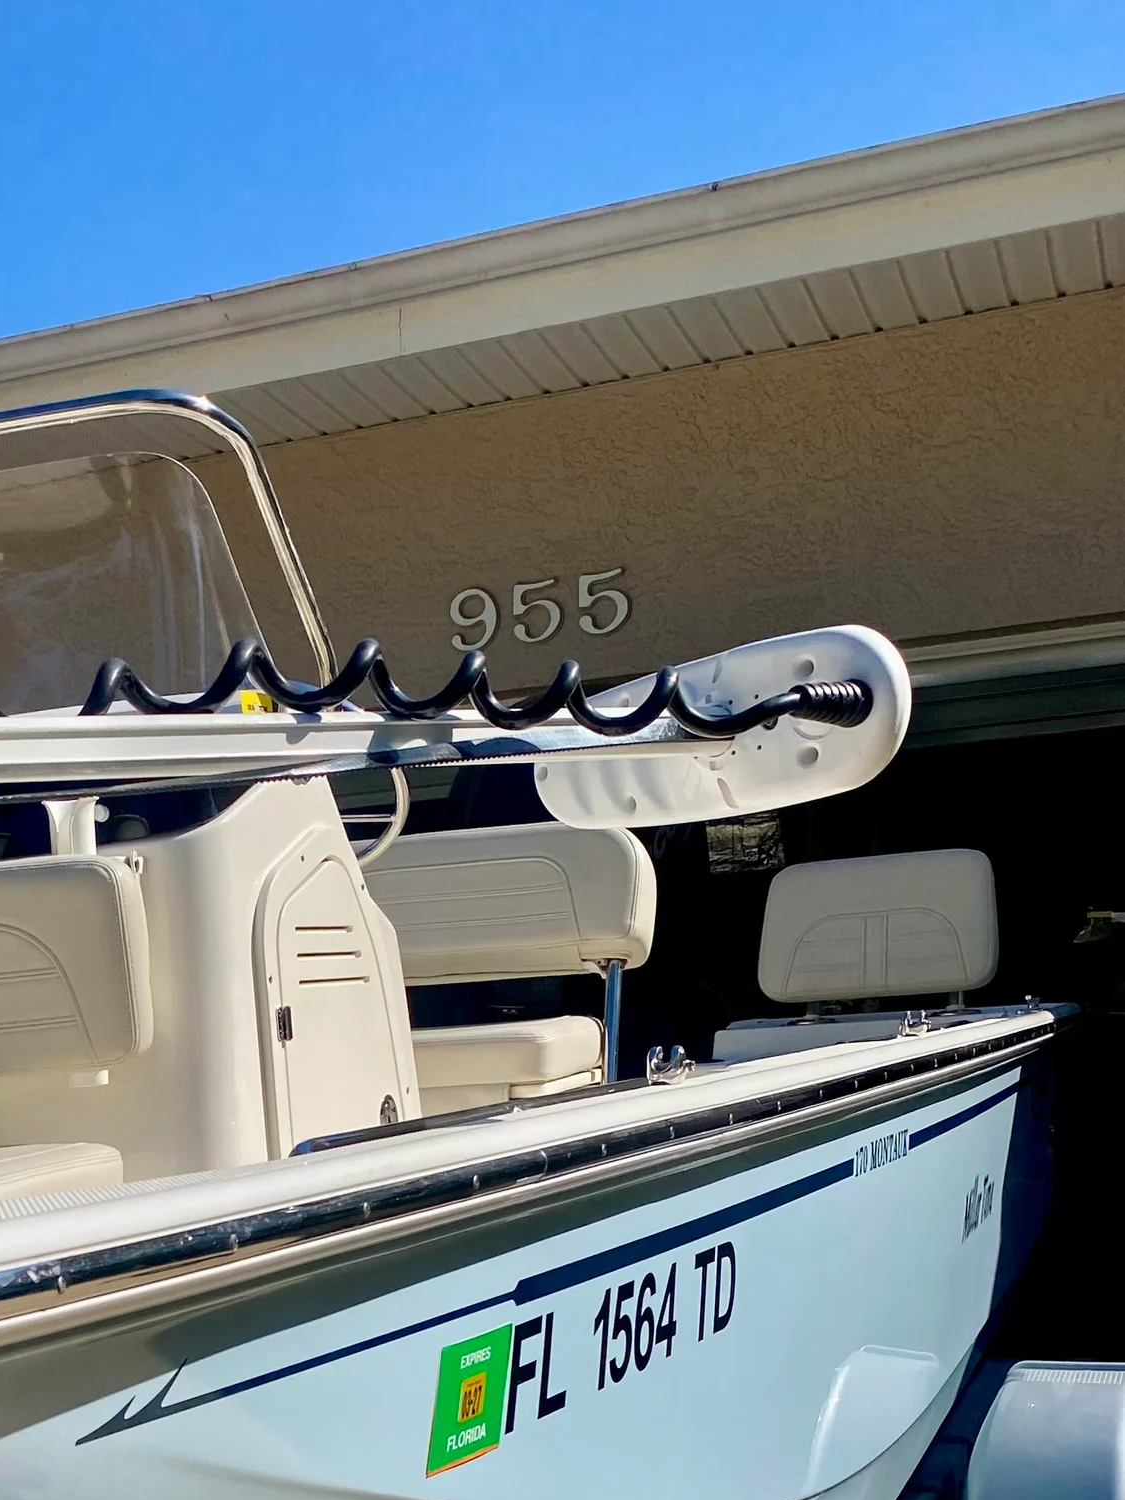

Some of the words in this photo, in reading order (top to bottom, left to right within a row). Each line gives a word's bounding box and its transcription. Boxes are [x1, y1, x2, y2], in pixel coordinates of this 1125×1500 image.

[450, 567, 629, 651] 955
[855, 1145, 868, 1177] 170
[870, 1129, 908, 1171] MONTAUK
[460, 1346, 492, 1370] EXPIRES
[505, 1311, 567, 1435] FL
[594, 1262, 677, 1391] 1564
[694, 1241, 736, 1342] TD
[446, 1422, 486, 1453] FLORIDA
